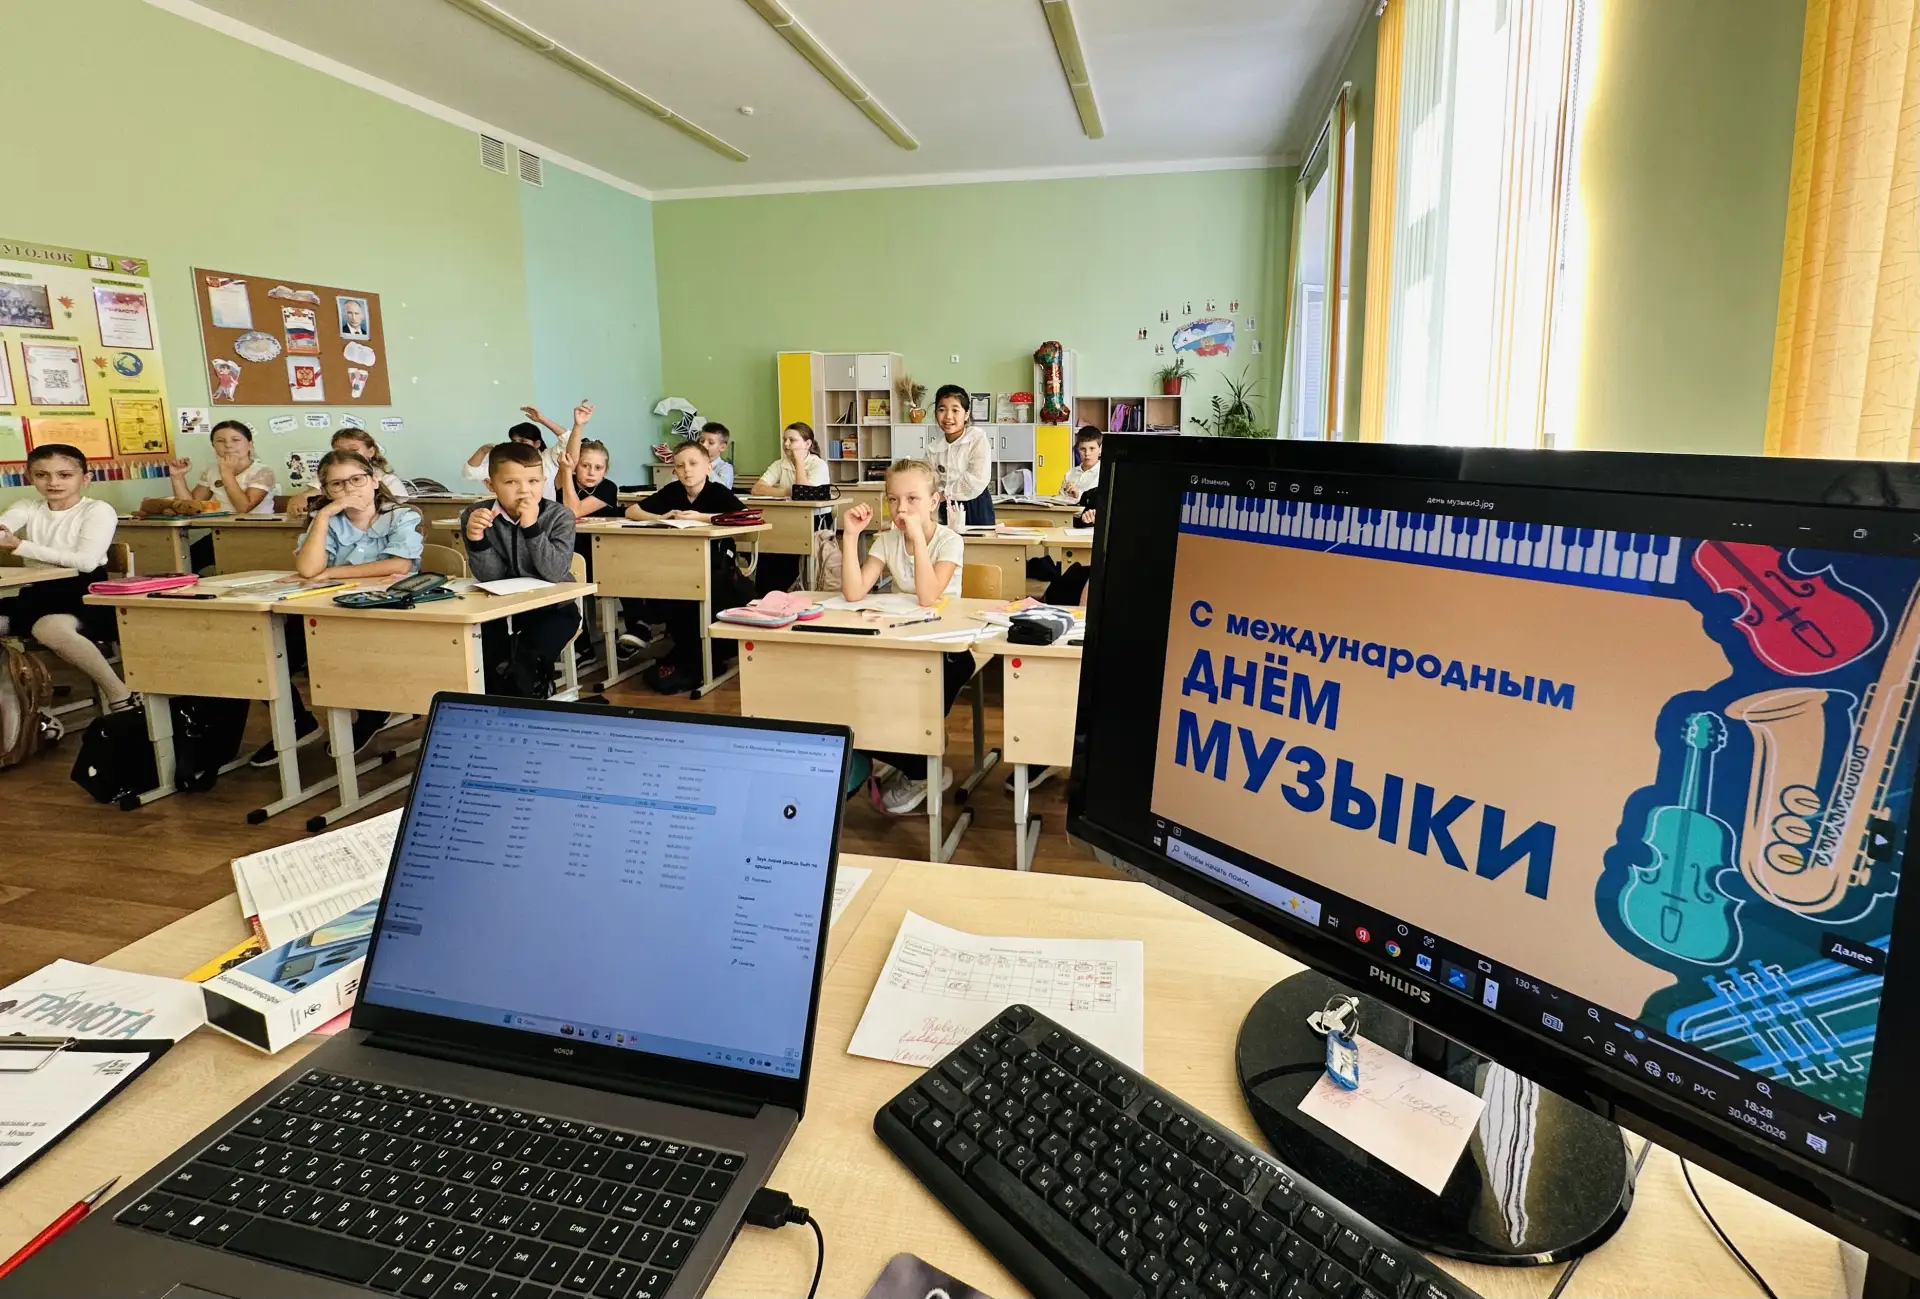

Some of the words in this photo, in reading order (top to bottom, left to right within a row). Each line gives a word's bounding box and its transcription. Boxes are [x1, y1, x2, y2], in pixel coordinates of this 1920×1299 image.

[1201, 477, 1230, 487] Изменить
[1447, 499, 1494, 510] музыки3.jpg
[1189, 600, 1213, 627] С
[1226, 612, 1575, 711] международным
[1181, 648, 1341, 731] ДНЁМ
[1174, 708, 1556, 900] МУЗЫКИ
[1183, 850, 1203, 865] Чтобы
[1204, 860, 1227, 877] начать
[1831, 942, 1874, 965] Далее
[1369, 965, 1431, 1004] PHILIPS
[1514, 977, 1530, 990] 130
[1532, 984, 1540, 995] %
[554, 1047, 574, 1056] HONOR
[1693, 1082, 1716, 1101] РУС
[1153, 1100, 1162, 1108] F5
[1744, 1099, 1773, 1119] 18:28
[1179, 1117, 1188, 1126] F6
[1727, 1105, 1787, 1141] 30.09.2026
[1206, 1135, 1216, 1144] F7
[1234, 1154, 1244, 1164] F8
[1249, 1155, 1296, 1189] OKLICK
[1278, 1184, 1289, 1195] F9
[1311, 1206, 1324, 1218] F10
[682, 1218, 696, 1226] PgUp
[569, 1224, 587, 1233] Enter
[1345, 1229, 1359, 1242] F11
[514, 1252, 529, 1261] Shift
[1381, 1253, 1396, 1267] F12
[574, 1275, 586, 1283] End
[454, 1282, 468, 1291] Ctrl
[636, 1290, 651, 1299] PgDn
